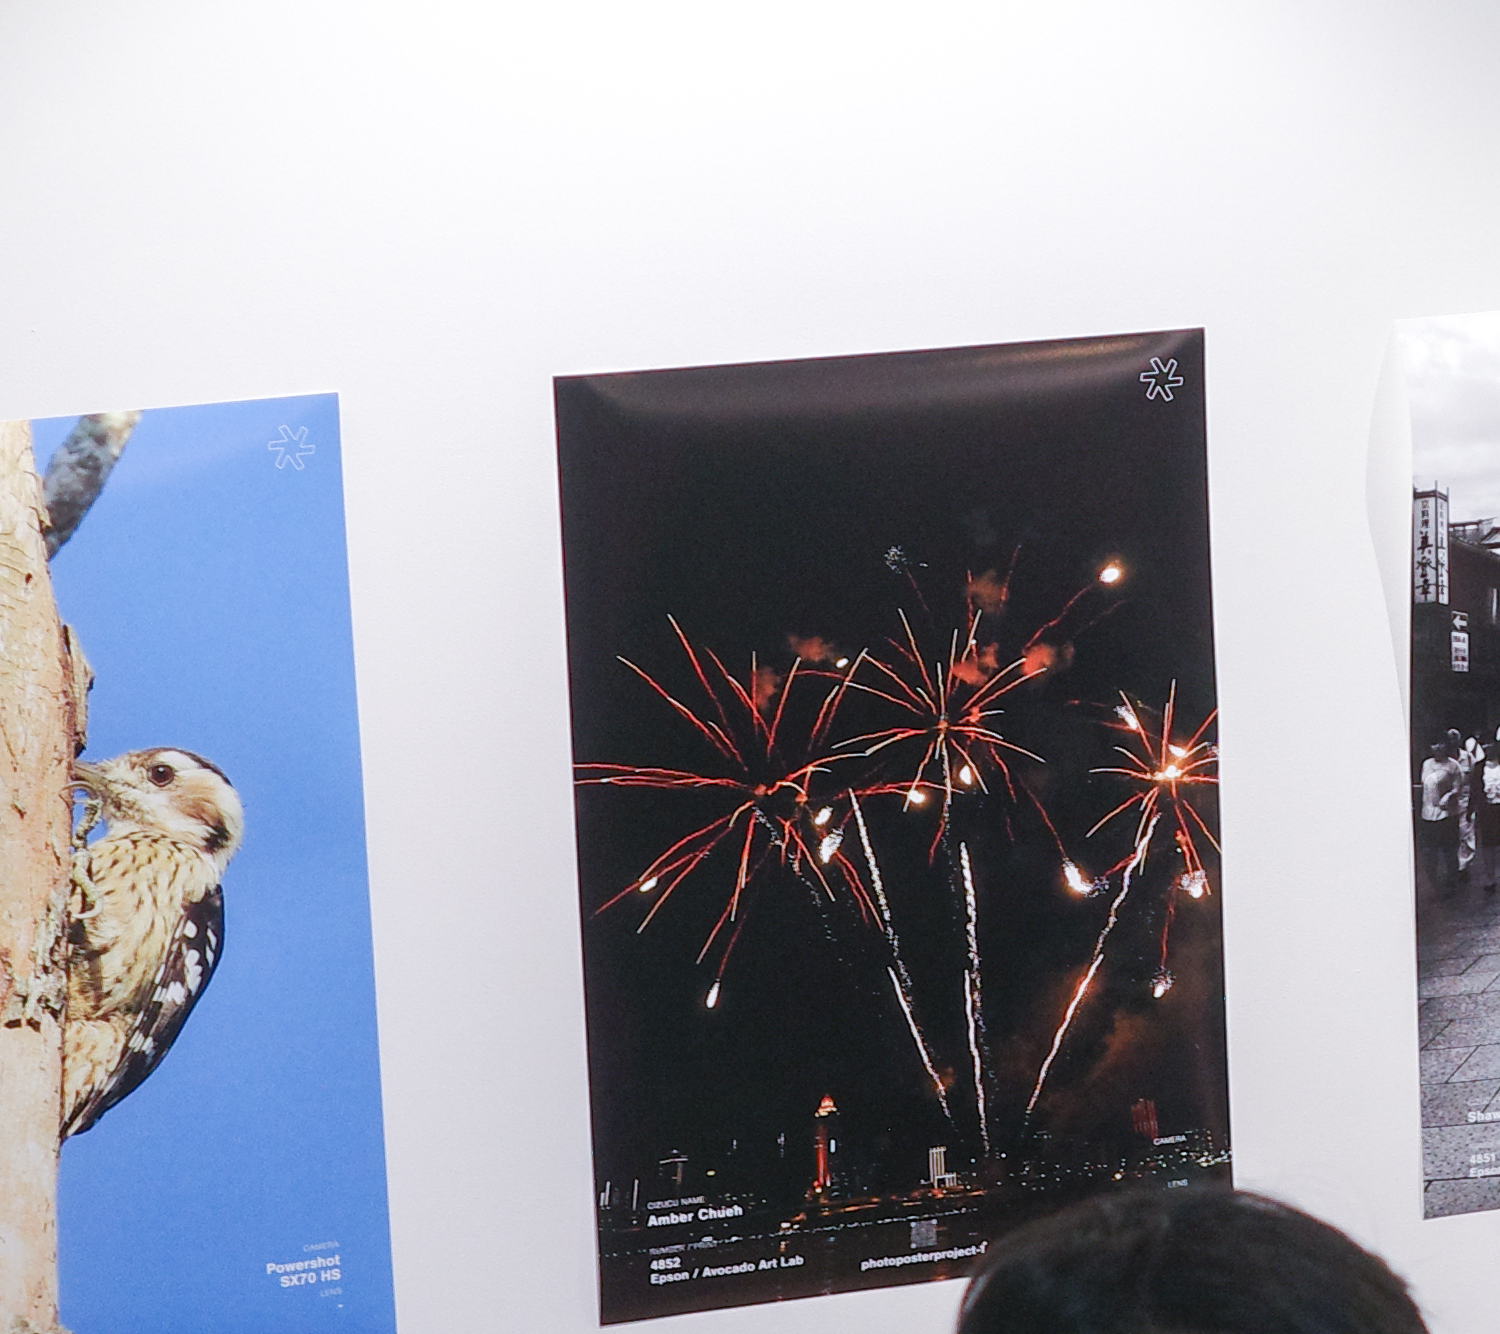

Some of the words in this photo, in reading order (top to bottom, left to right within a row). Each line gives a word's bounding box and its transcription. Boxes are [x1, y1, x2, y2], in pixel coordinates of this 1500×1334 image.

[1469, 1153, 1496, 1165] 4851
[647, 1212, 694, 1227] Amber
[697, 1205, 744, 1220] Chueh
[266, 1254, 341, 1275] Powershot
[650, 1257, 681, 1271] 4852
[650, 1271, 690, 1285] Epson
[702, 1261, 756, 1277] Avocado
[758, 1258, 779, 1270] Art
[780, 1255, 805, 1267] Lab
[280, 1272, 316, 1288] SX70
[320, 1268, 341, 1282] HS
